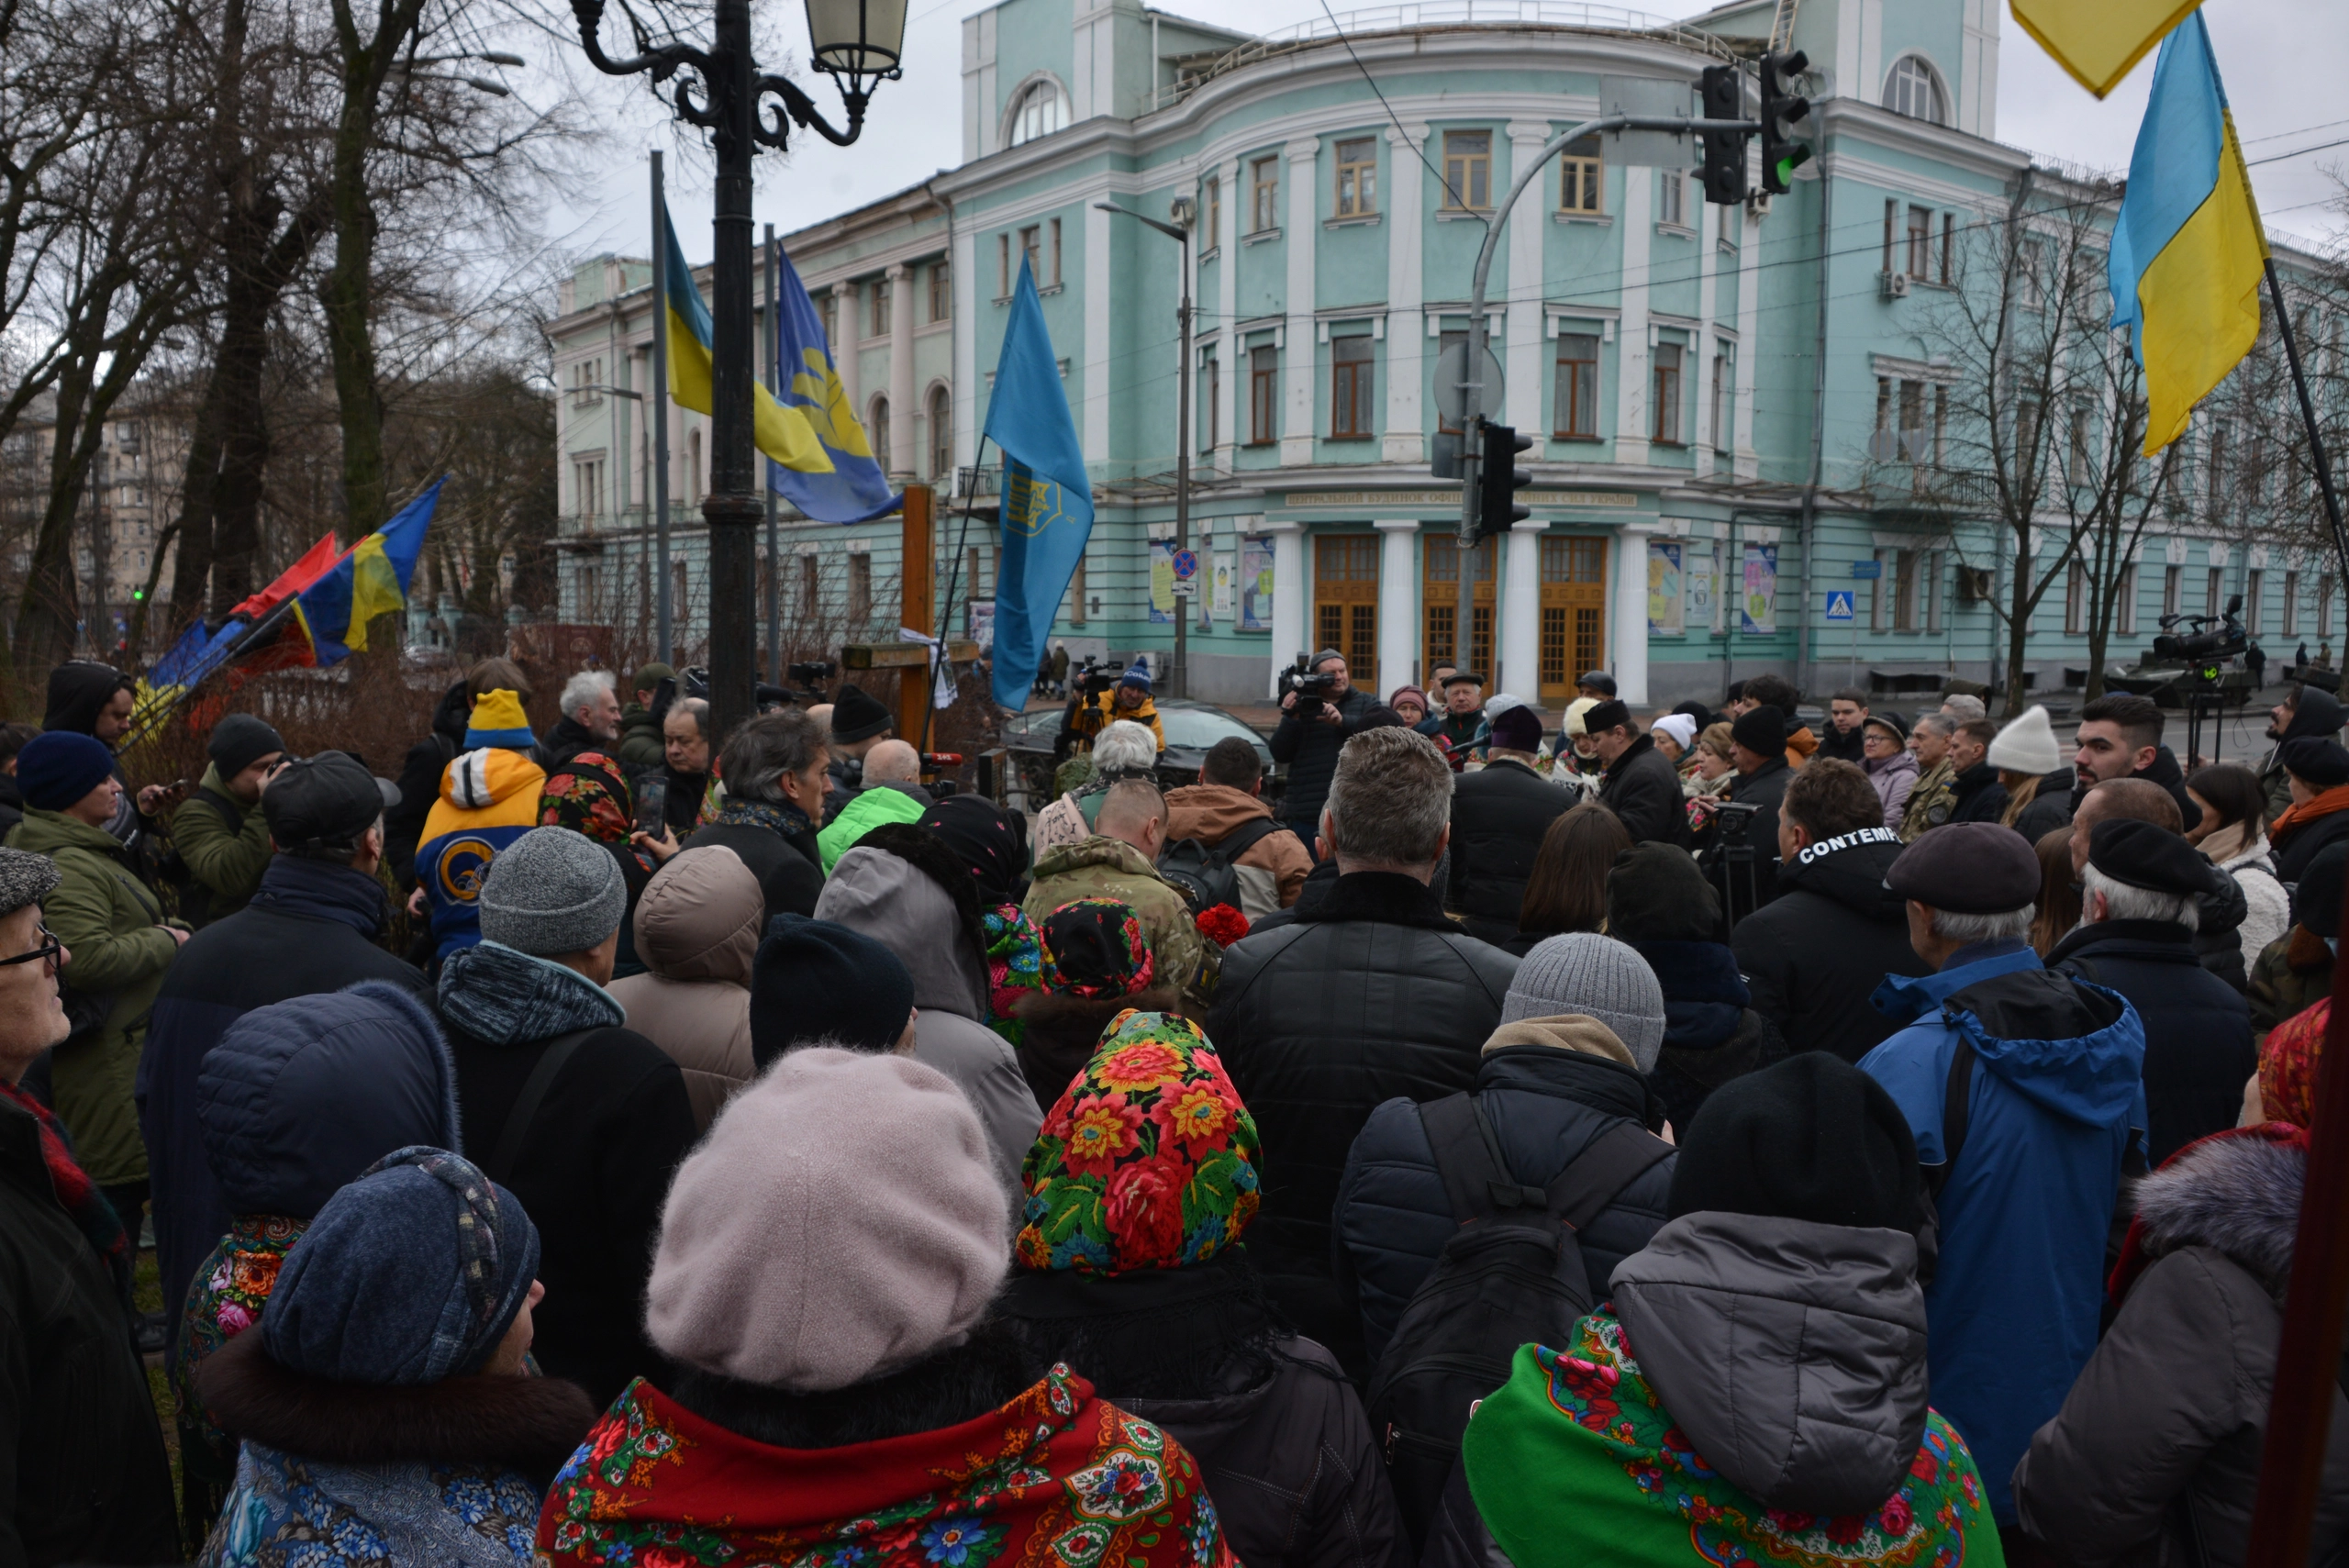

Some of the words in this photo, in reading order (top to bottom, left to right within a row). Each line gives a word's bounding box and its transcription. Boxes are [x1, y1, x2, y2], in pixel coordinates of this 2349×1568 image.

[1287, 493, 1364, 505] ЦЕНТРАЛЬНИЙ
[1367, 492, 1426, 504] БУДИНОК
[1429, 493, 1462, 504] ОФІЦ
[1562, 495, 1586, 505] СИЛ
[1590, 494, 1637, 506] УКРАЇНИ
[1799, 827, 1903, 864] CONTEMP
